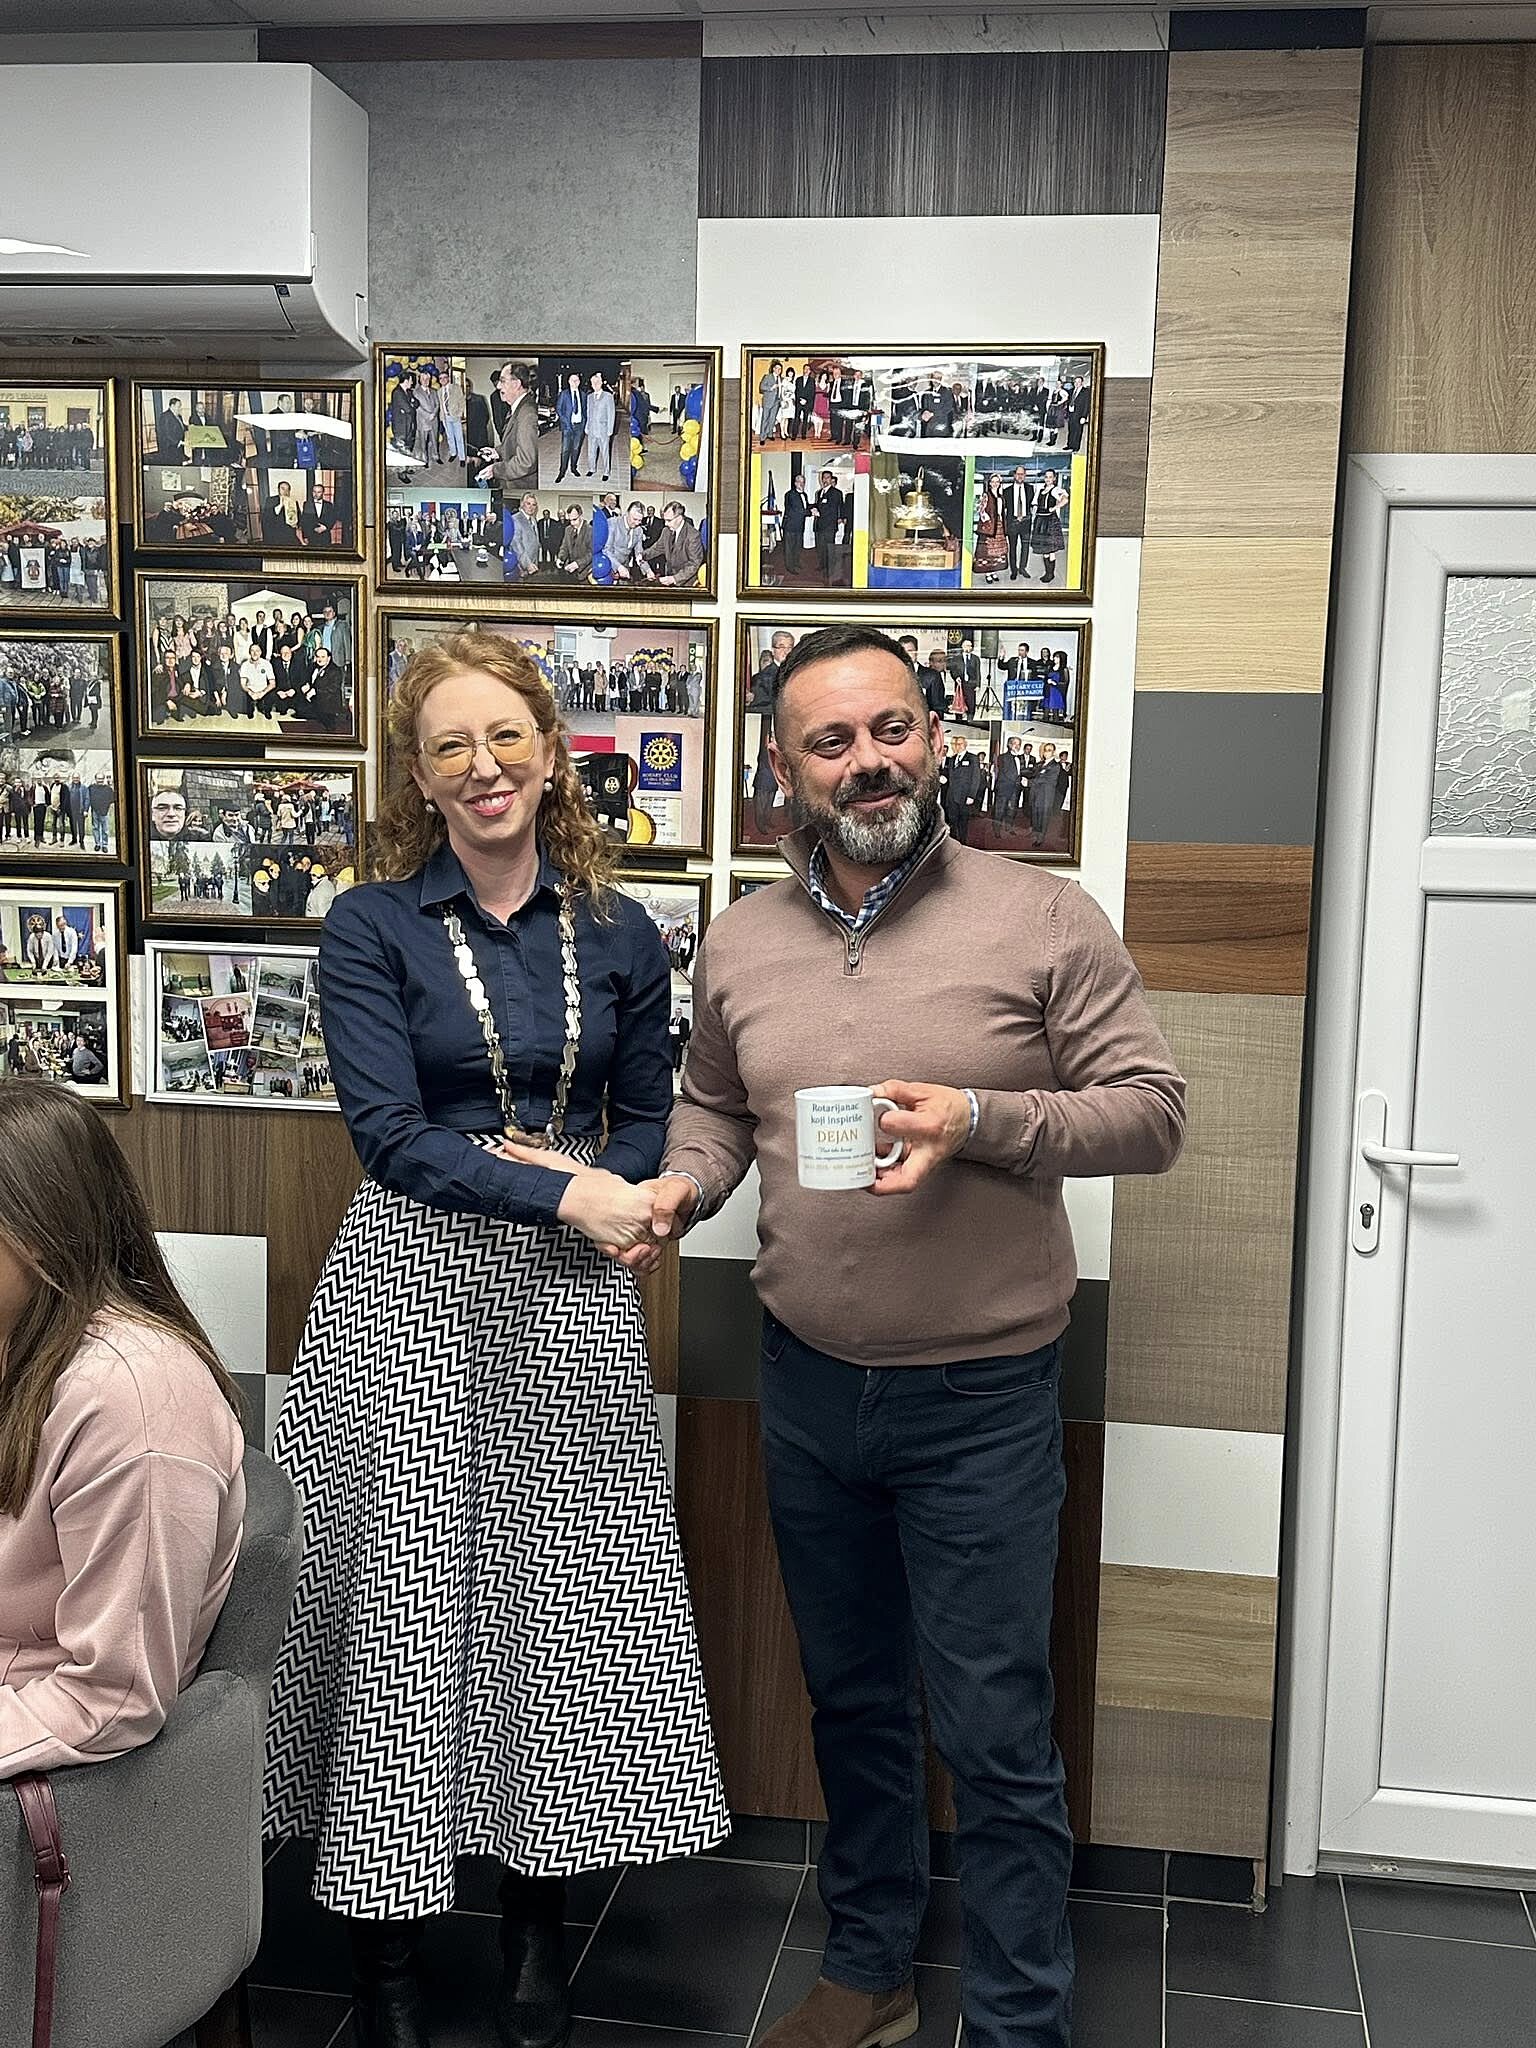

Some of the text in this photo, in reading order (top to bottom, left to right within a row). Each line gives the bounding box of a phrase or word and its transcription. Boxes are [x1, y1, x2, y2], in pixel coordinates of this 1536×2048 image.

[812, 1103, 860, 1114] Rotarijanac
[811, 1115, 826, 1126] koji
[817, 1128, 858, 1144] DEJAN
